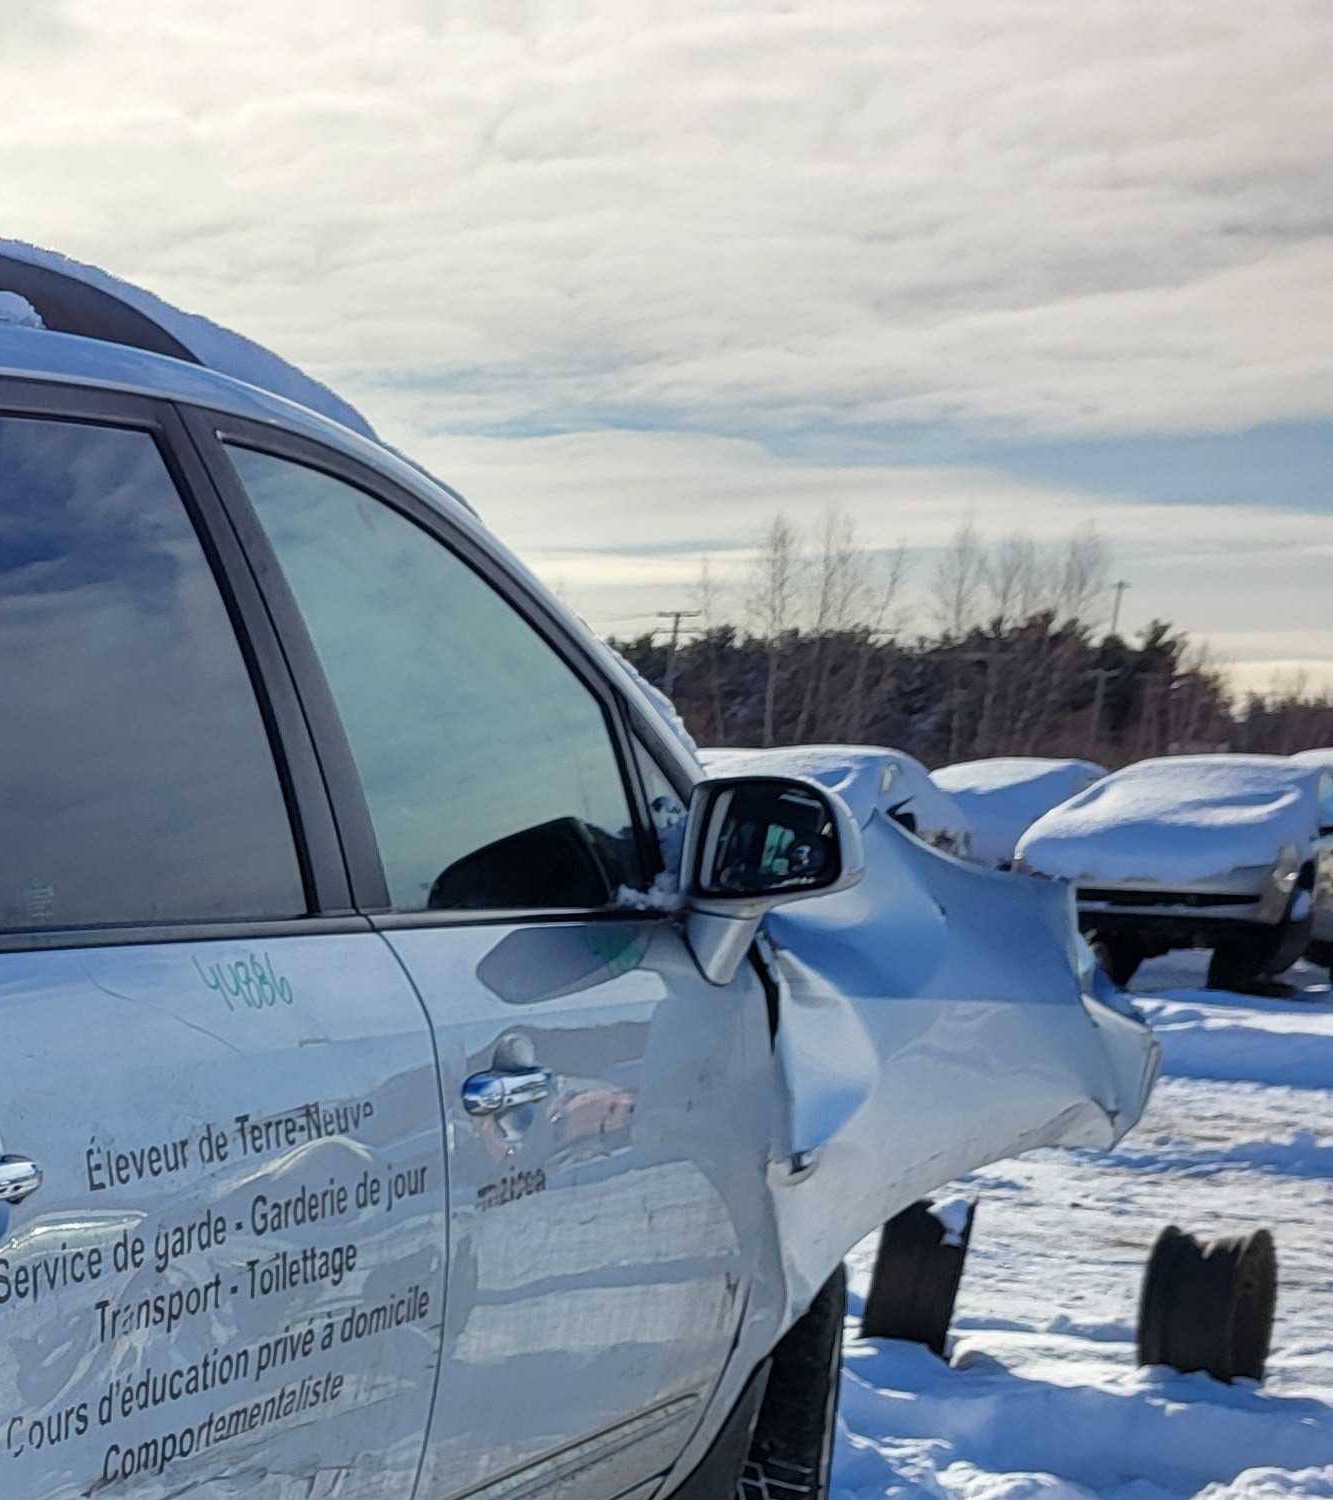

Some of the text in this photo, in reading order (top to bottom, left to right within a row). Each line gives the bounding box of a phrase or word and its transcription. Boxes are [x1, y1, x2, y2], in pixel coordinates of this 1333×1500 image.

[86, 1136, 189, 1192] Éleveur
[199, 1124, 229, 1164] de
[113, 1229, 145, 1273] de
[154, 1208, 227, 1274] garde
[251, 1177, 348, 1236] Garderie
[355, 1170, 381, 1209] de
[386, 1163, 428, 1213] jour
[94, 1272, 222, 1343] Transport
[246, 1243, 358, 1300] Toilettage
[6, 1284, 430, 1458] Cours d'éducation privé à domicile
[102, 1370, 345, 1483] Comportementaliste
